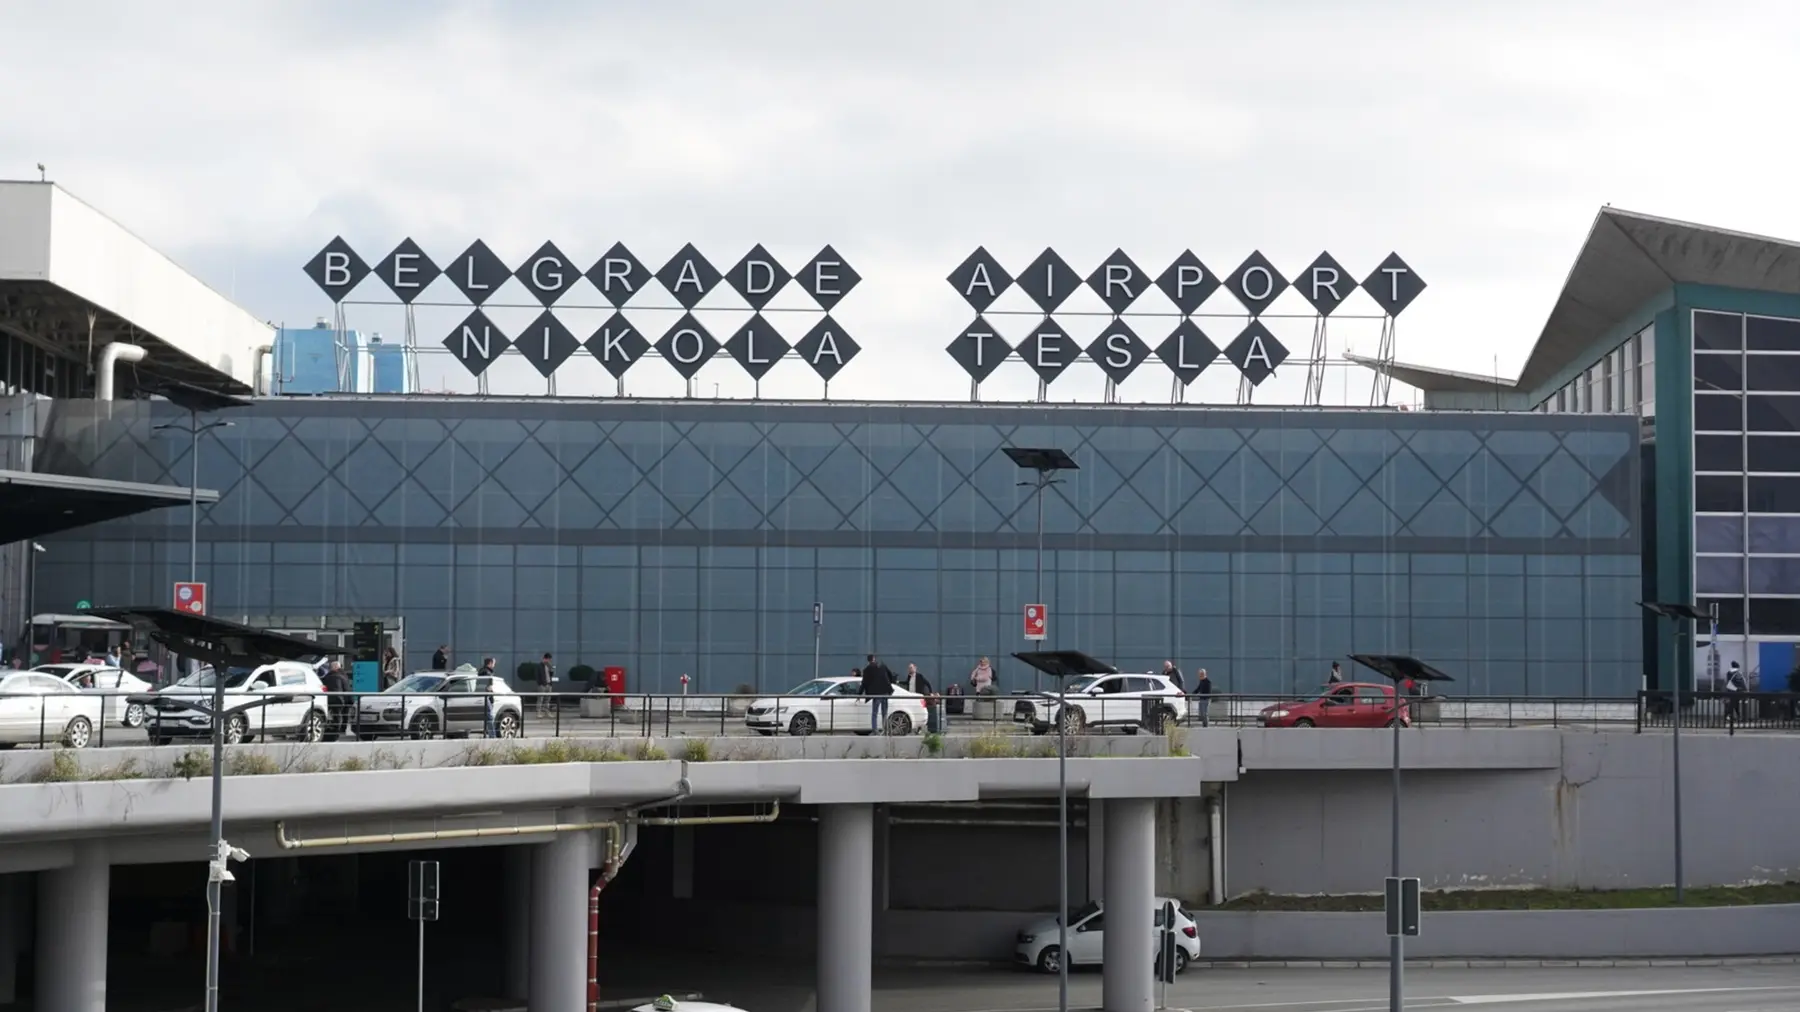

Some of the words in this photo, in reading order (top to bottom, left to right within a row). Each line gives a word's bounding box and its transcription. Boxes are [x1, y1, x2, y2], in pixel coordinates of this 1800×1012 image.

[324, 251, 841, 296] BELGRADE
[965, 262, 1409, 301] AIRPORT
[462, 325, 843, 365] NIKOLA
[966, 332, 1273, 369] TESLA
